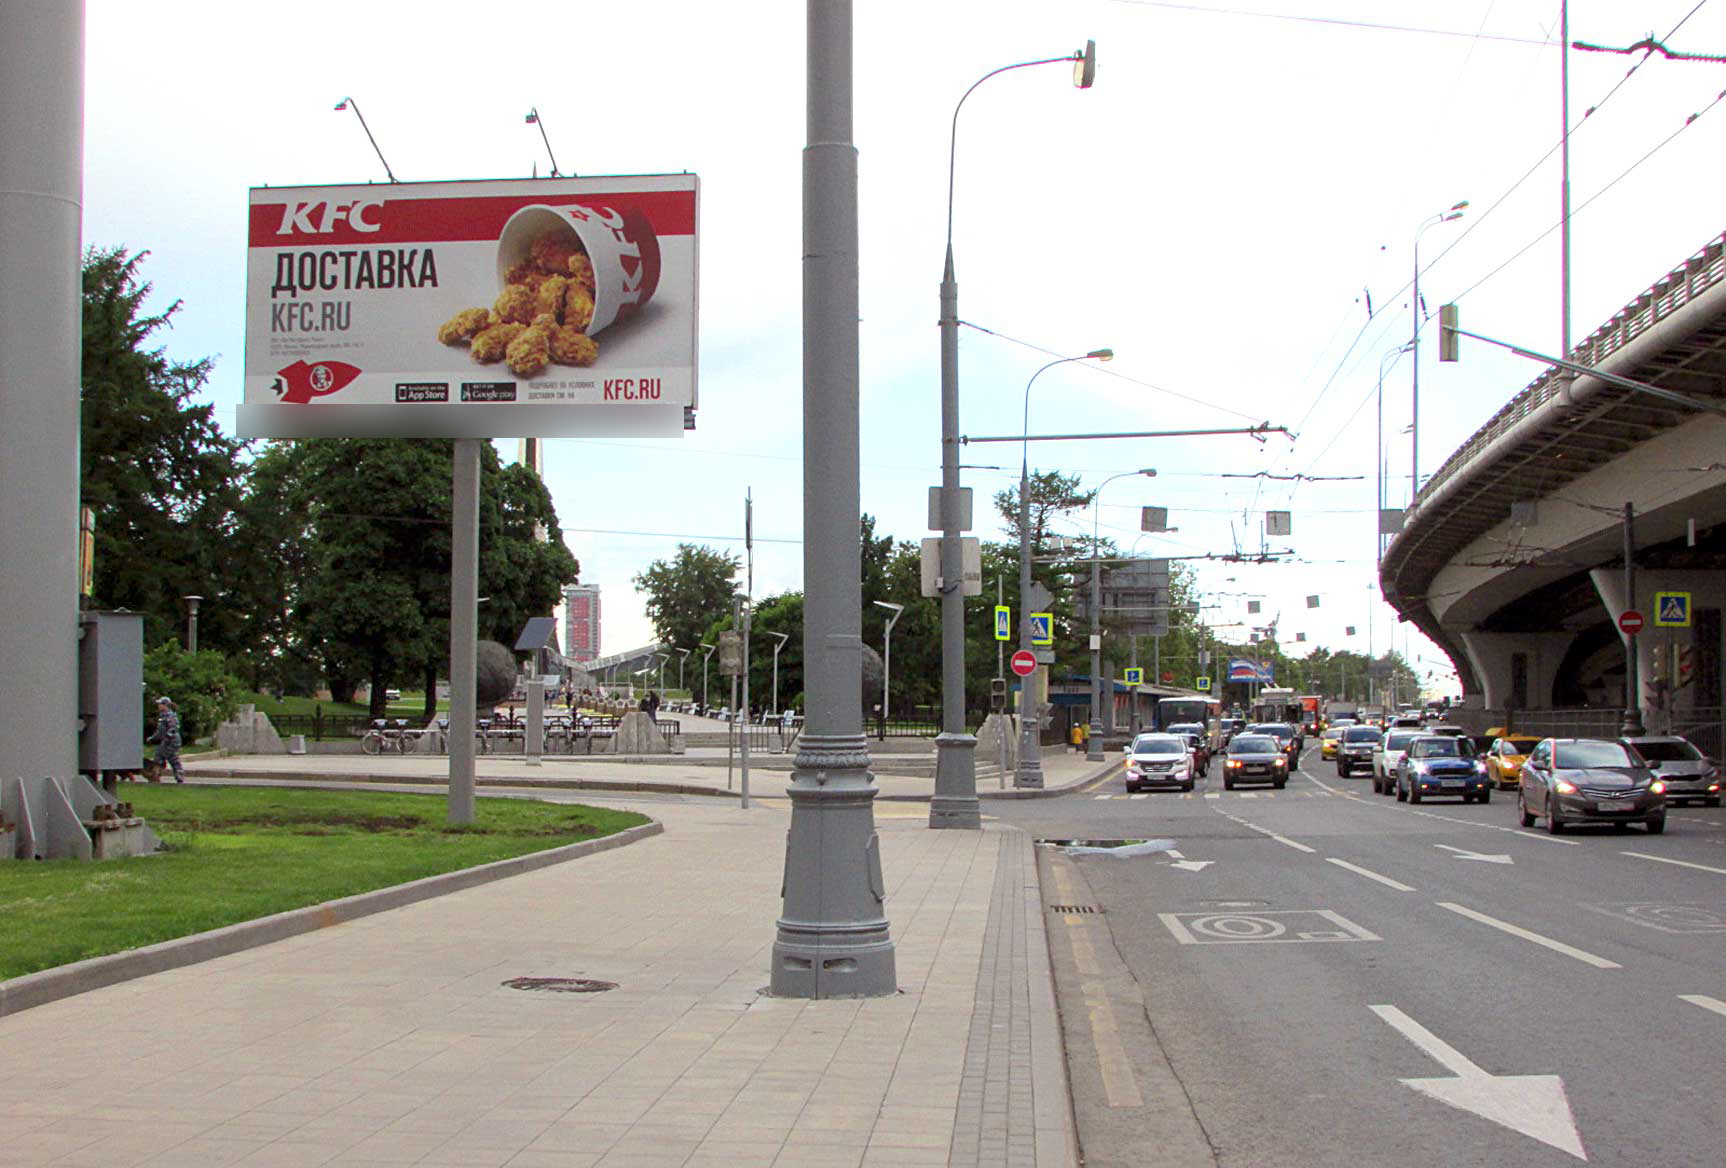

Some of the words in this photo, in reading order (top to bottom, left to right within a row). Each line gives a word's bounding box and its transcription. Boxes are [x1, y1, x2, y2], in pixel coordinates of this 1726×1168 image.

[276, 200, 386, 235] KFC
[271, 249, 438, 298] ДОСТАВКА
[271, 301, 351, 333] KFC.RU
[425, 390, 446, 400] Store
[604, 378, 660, 400] KFC.RU
